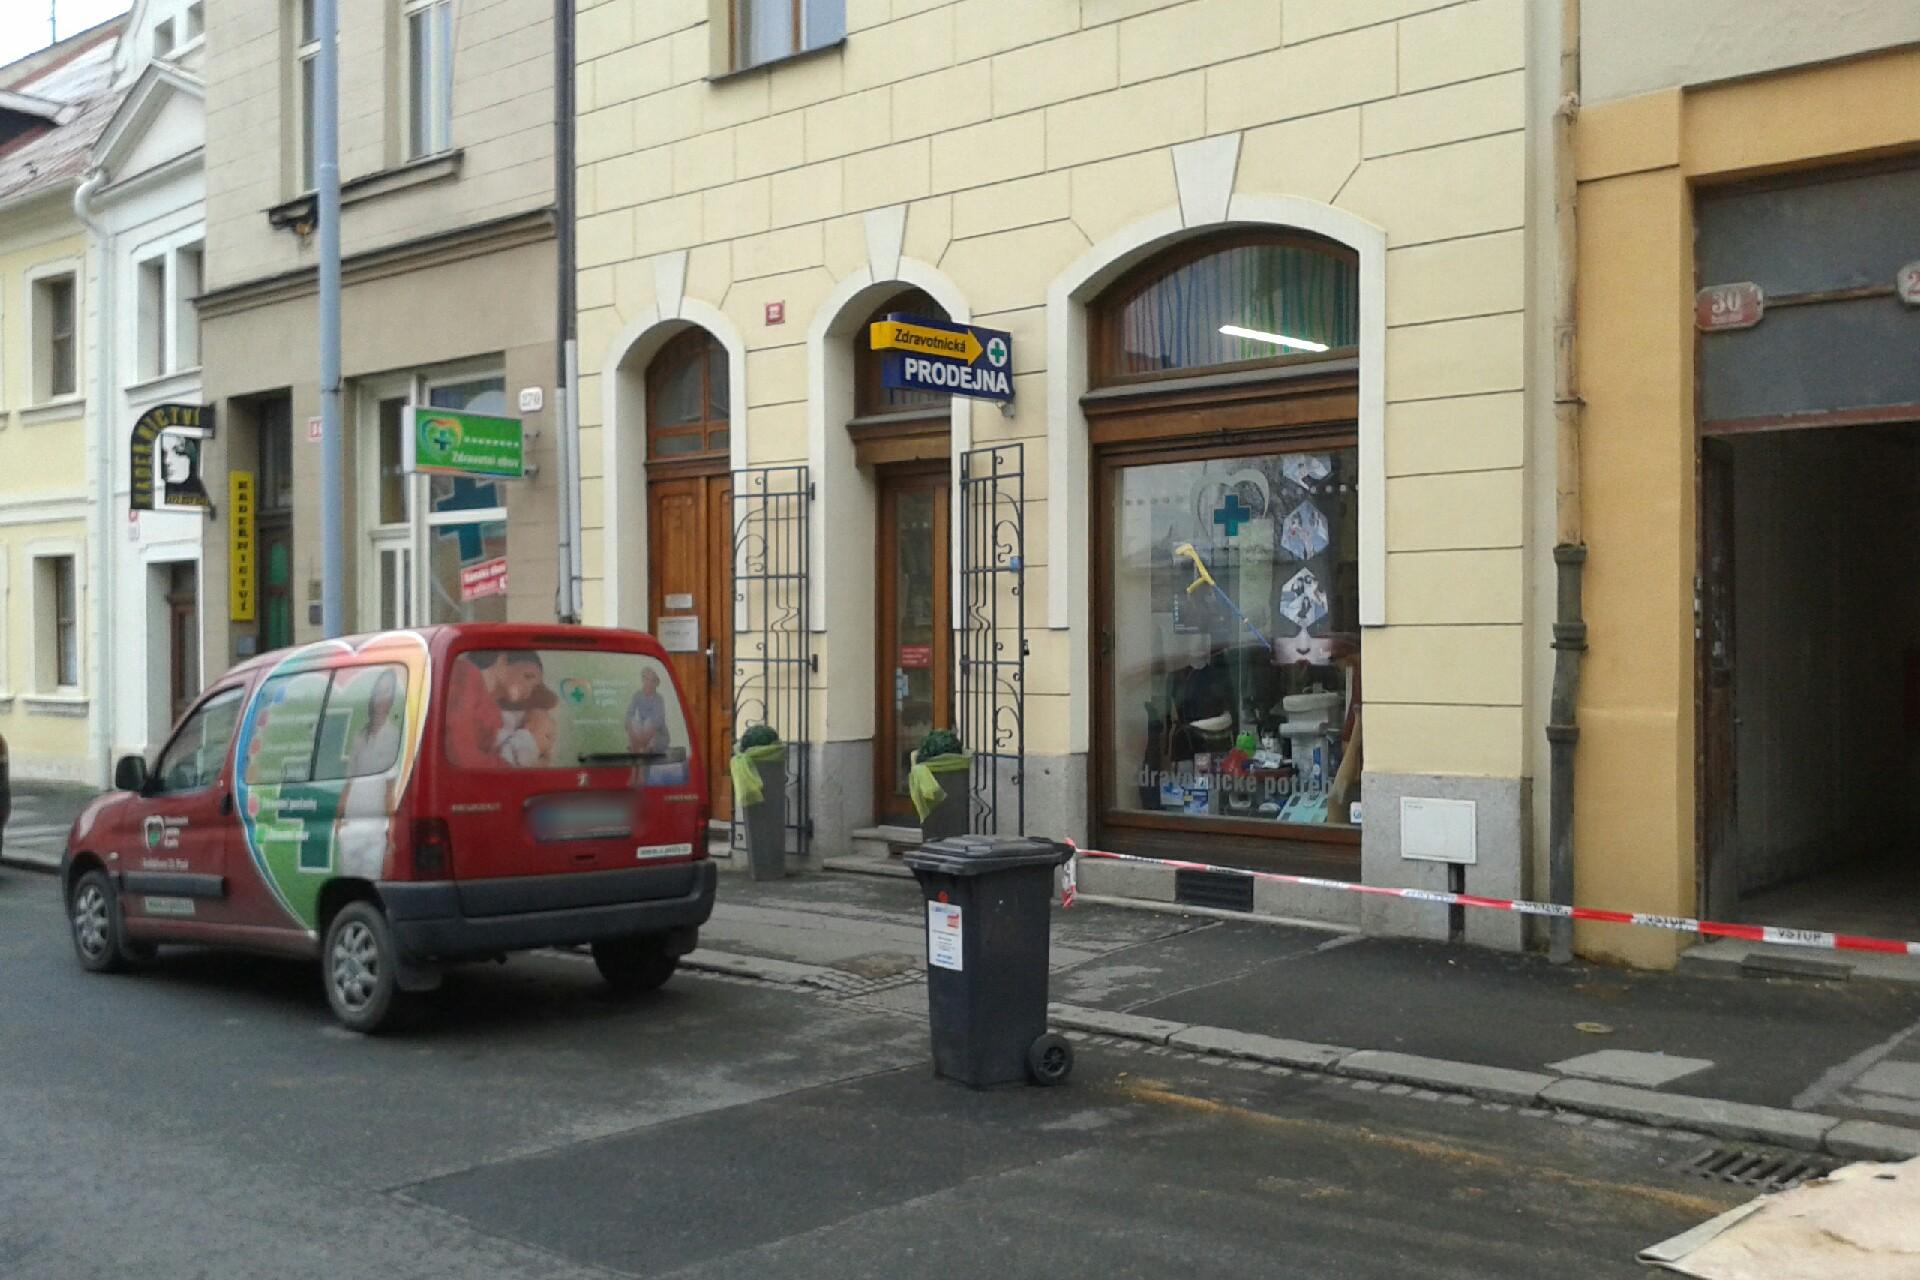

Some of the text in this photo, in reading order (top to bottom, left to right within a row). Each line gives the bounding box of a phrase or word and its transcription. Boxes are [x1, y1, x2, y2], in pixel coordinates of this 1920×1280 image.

[1711, 290, 1741, 314] 30
[894, 328, 966, 353] Zdravotnická
[905, 357, 1009, 394] PRODEJNA
[1778, 929, 1821, 943] VSTUP
